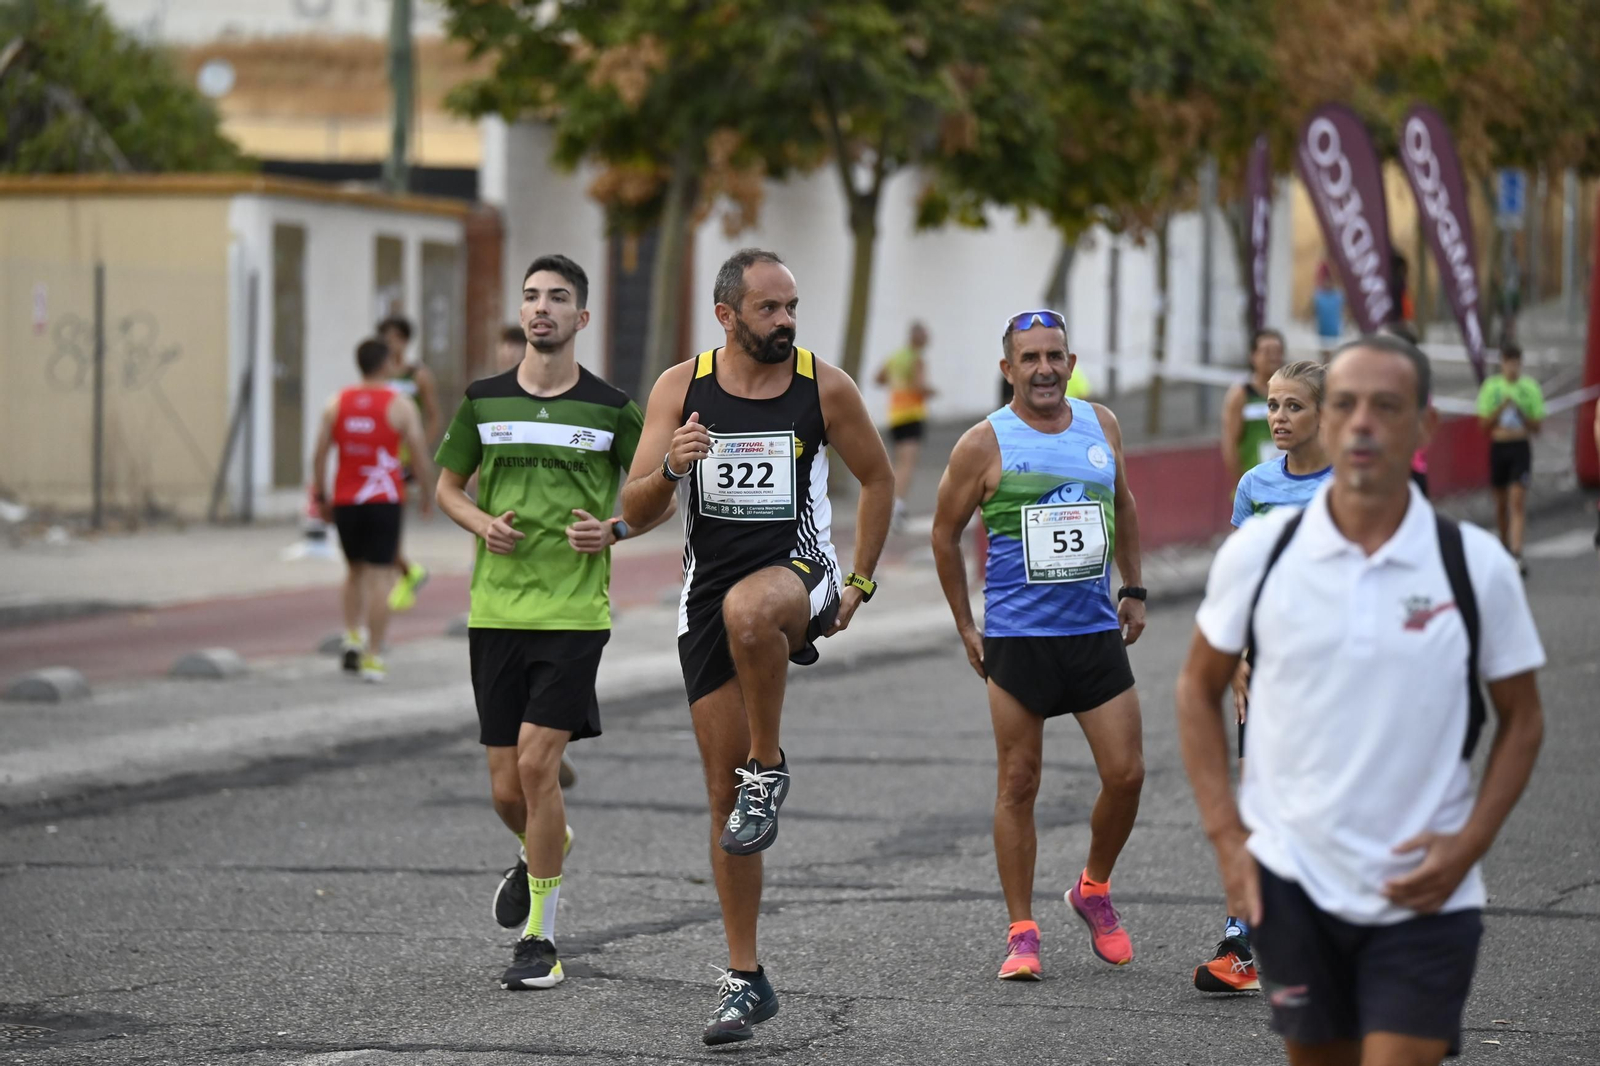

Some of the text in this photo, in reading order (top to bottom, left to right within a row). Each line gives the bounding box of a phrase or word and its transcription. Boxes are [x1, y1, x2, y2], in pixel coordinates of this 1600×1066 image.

[493, 456, 538, 468] ATLETISMO
[717, 462, 775, 489] 322
[732, 506, 745, 515] 3k
[1053, 529, 1084, 554] 53
[1056, 568, 1068, 577] 5k
